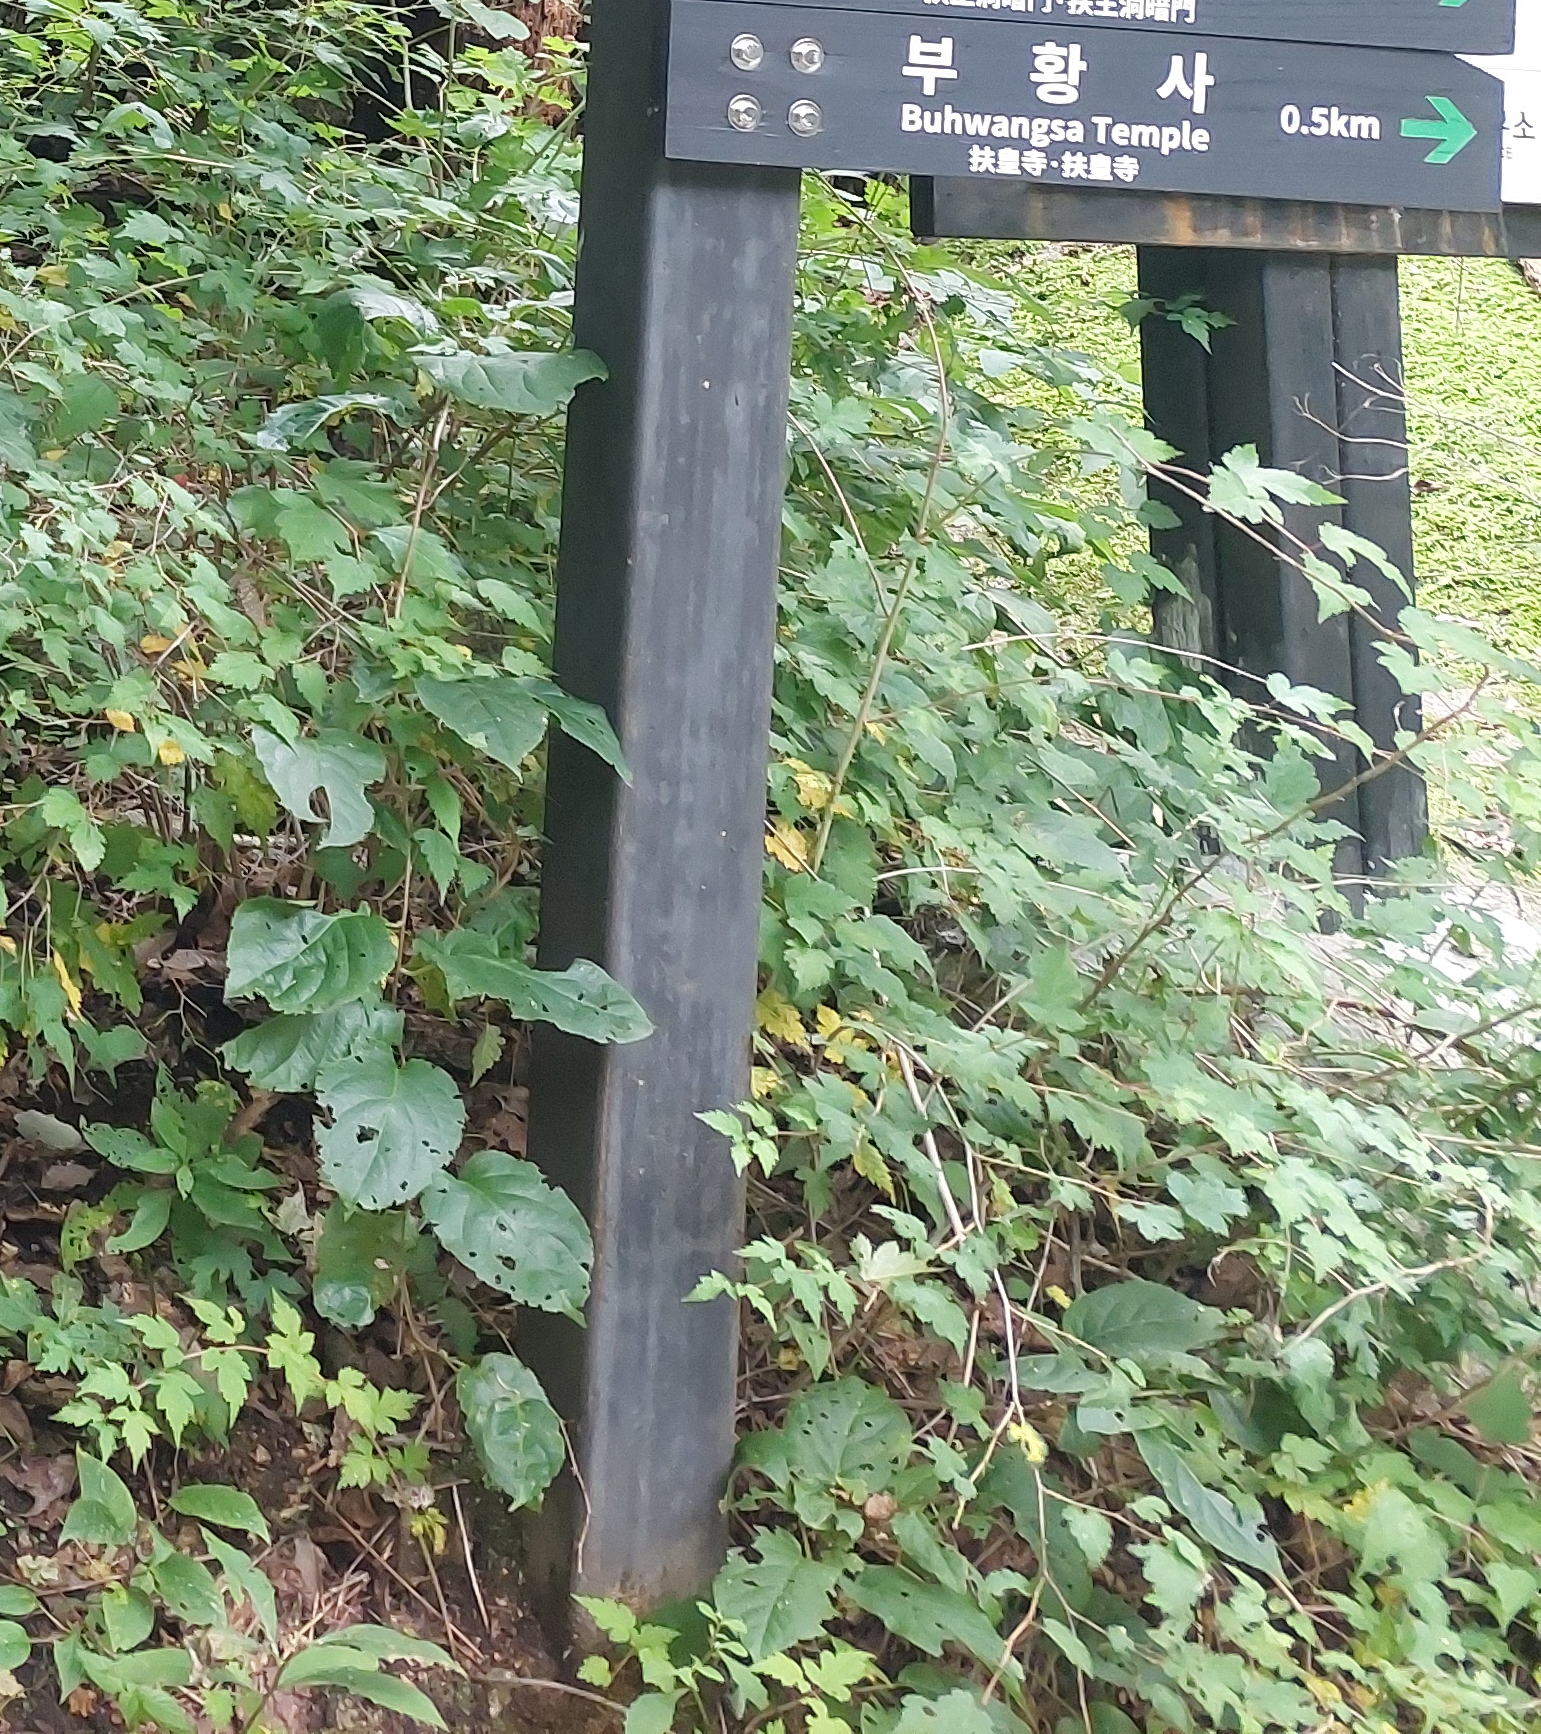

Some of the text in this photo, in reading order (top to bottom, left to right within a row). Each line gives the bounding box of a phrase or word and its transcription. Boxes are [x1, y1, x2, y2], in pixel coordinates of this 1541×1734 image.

[901, 35, 1216, 115] 부황사
[901, 103, 1211, 155] Buhwangsa Temple
[1279, 104, 1381, 140] 0.5km
